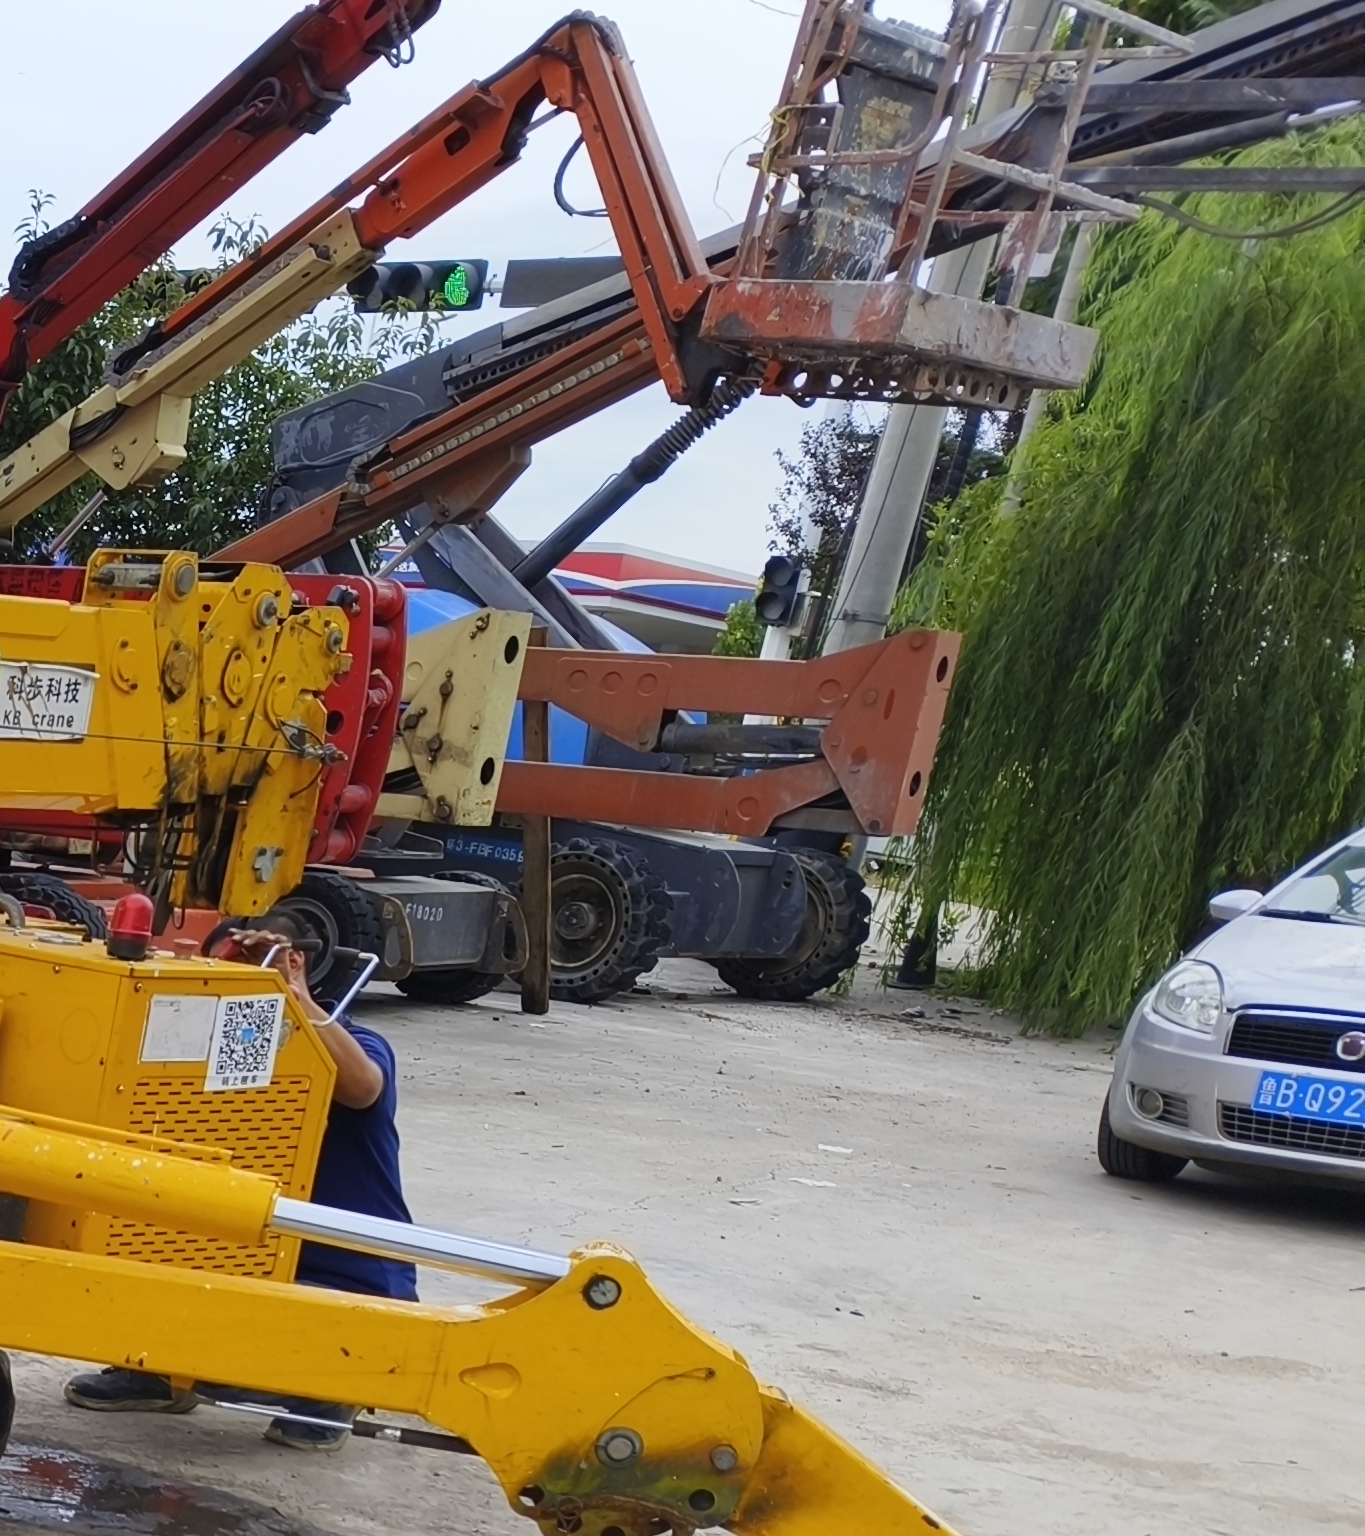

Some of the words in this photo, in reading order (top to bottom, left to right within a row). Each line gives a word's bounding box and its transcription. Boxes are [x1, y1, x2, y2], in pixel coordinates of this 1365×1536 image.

[7, 675, 82, 704] 科步科技
[3, 709, 21, 726] KB
[32, 713, 74, 728] crane
